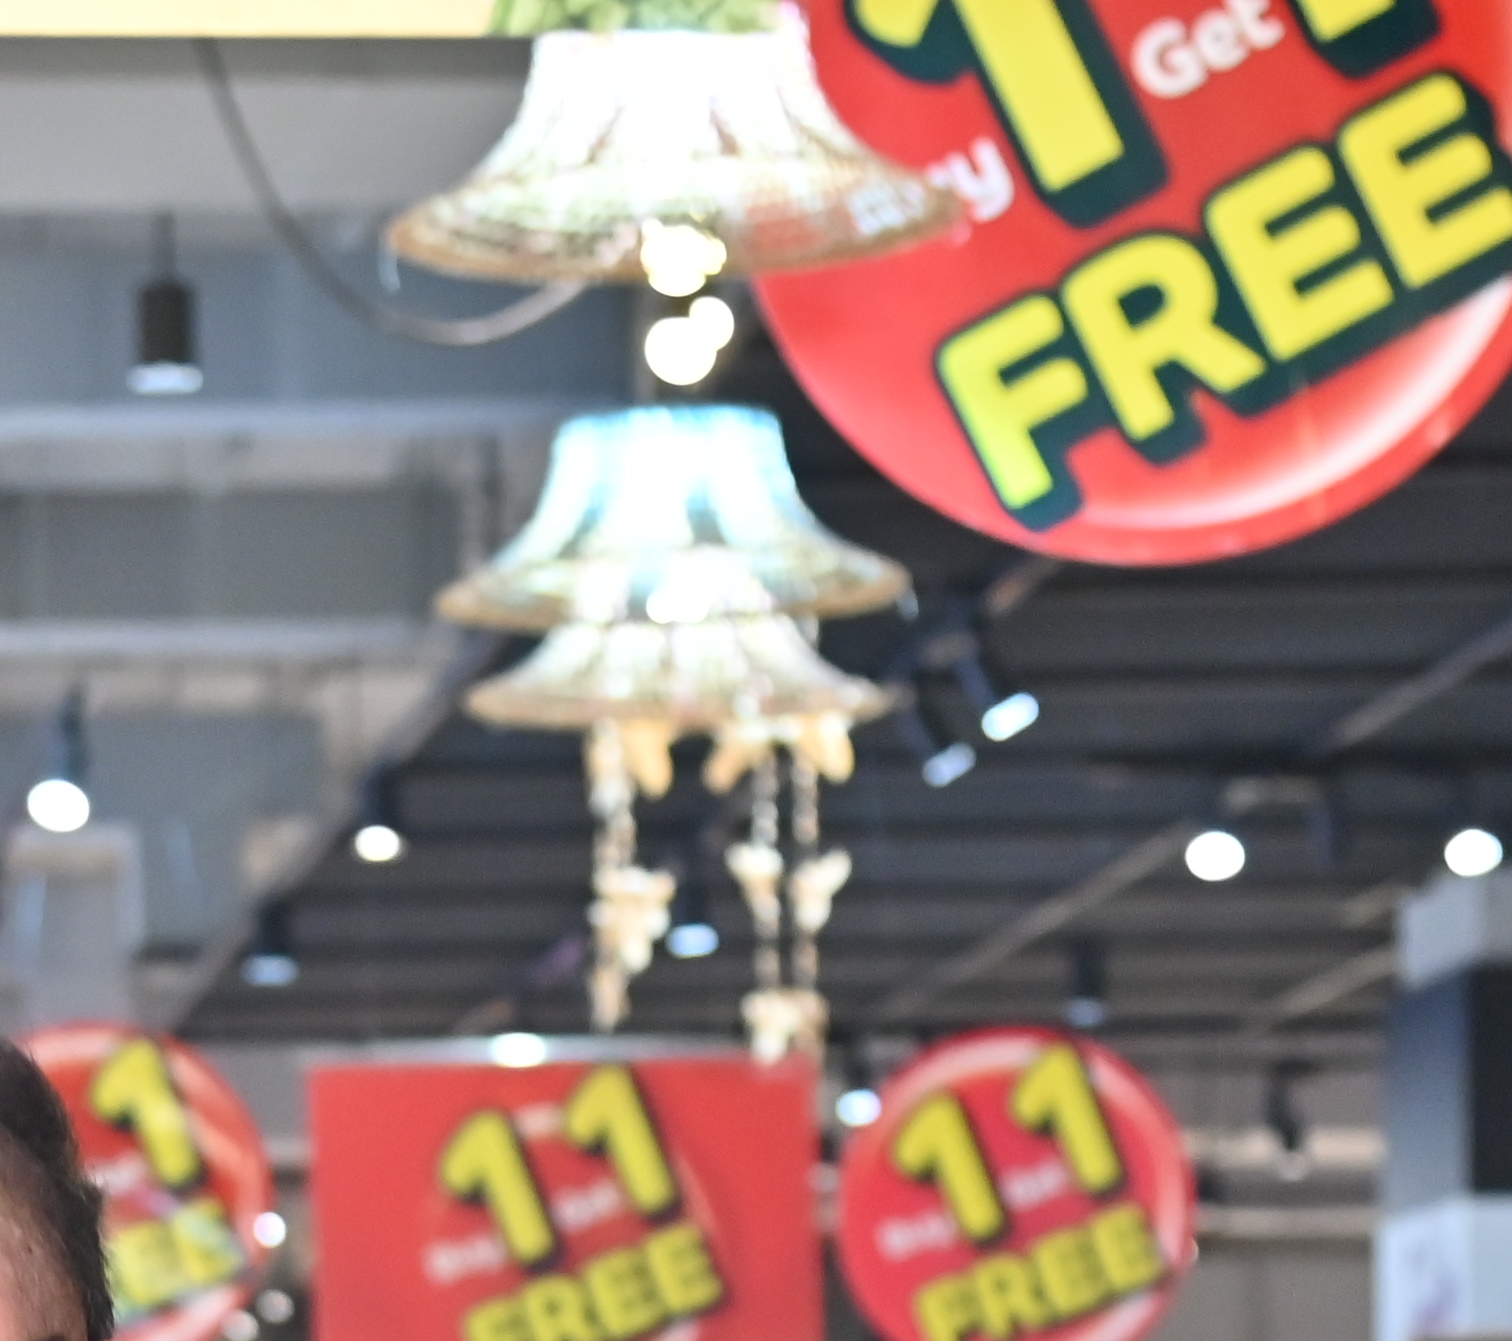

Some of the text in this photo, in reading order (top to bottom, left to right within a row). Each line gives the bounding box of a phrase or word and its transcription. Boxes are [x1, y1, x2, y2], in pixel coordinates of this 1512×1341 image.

[438, 1063, 676, 1266] 1 1
[892, 1042, 1121, 1242] 1 1
